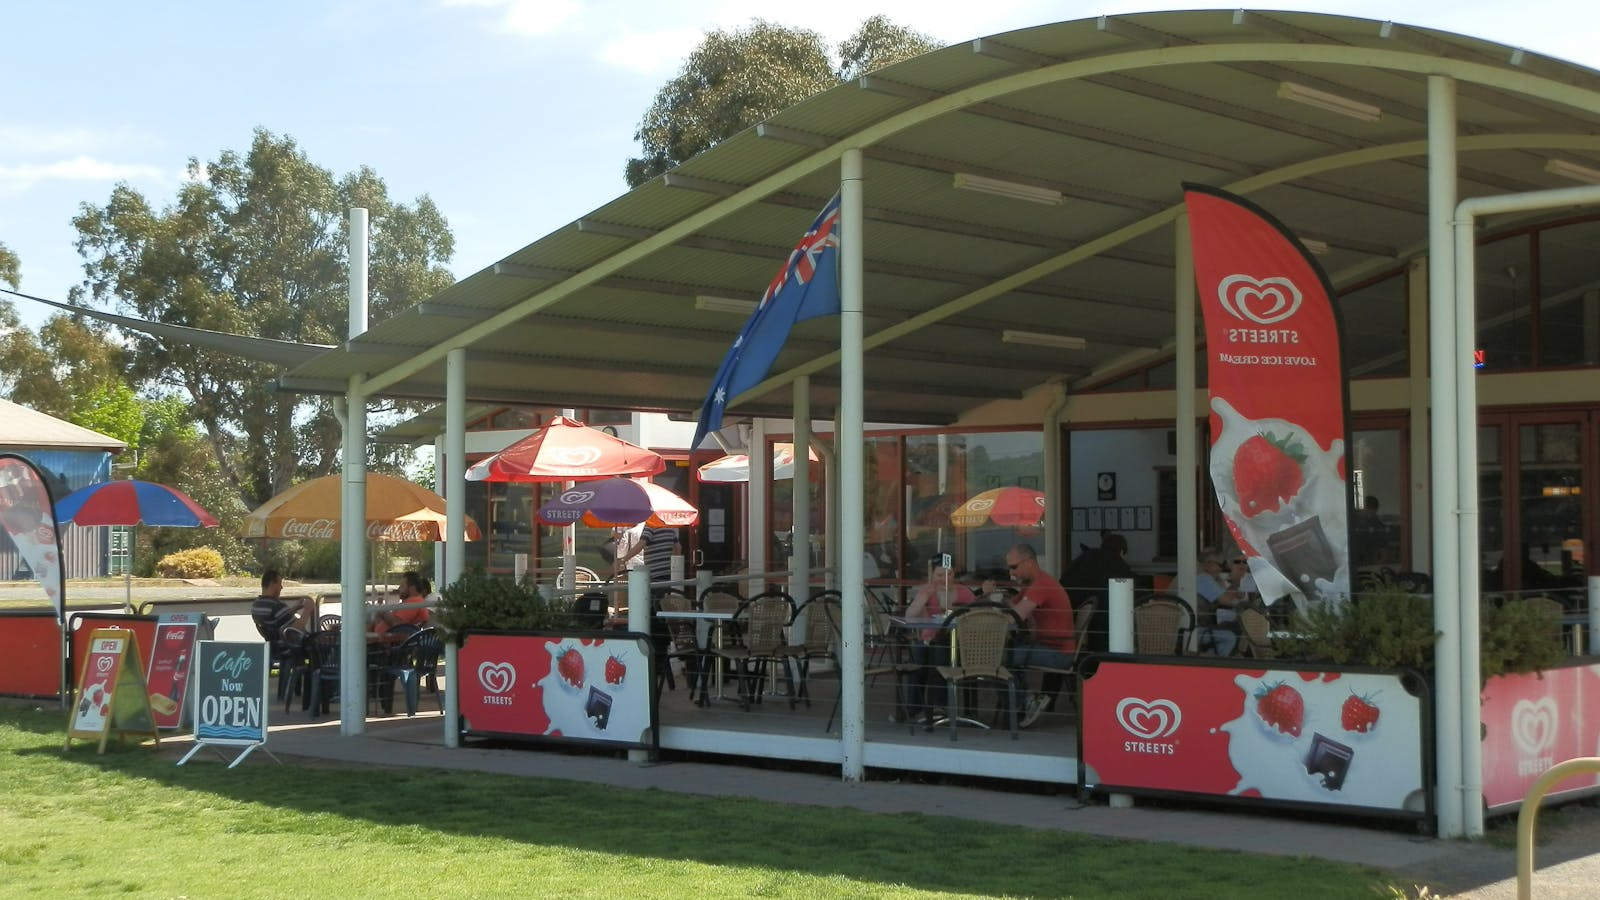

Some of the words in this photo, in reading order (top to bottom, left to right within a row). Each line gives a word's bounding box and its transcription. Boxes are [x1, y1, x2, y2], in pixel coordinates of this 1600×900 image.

[546, 509, 581, 520] STREETS
[212, 650, 252, 679] Cafe
[221, 678, 243, 692] Now
[483, 695, 512, 705] STREETS
[202, 695, 260, 727] OPEN
[1124, 741, 1174, 755] STREETS
